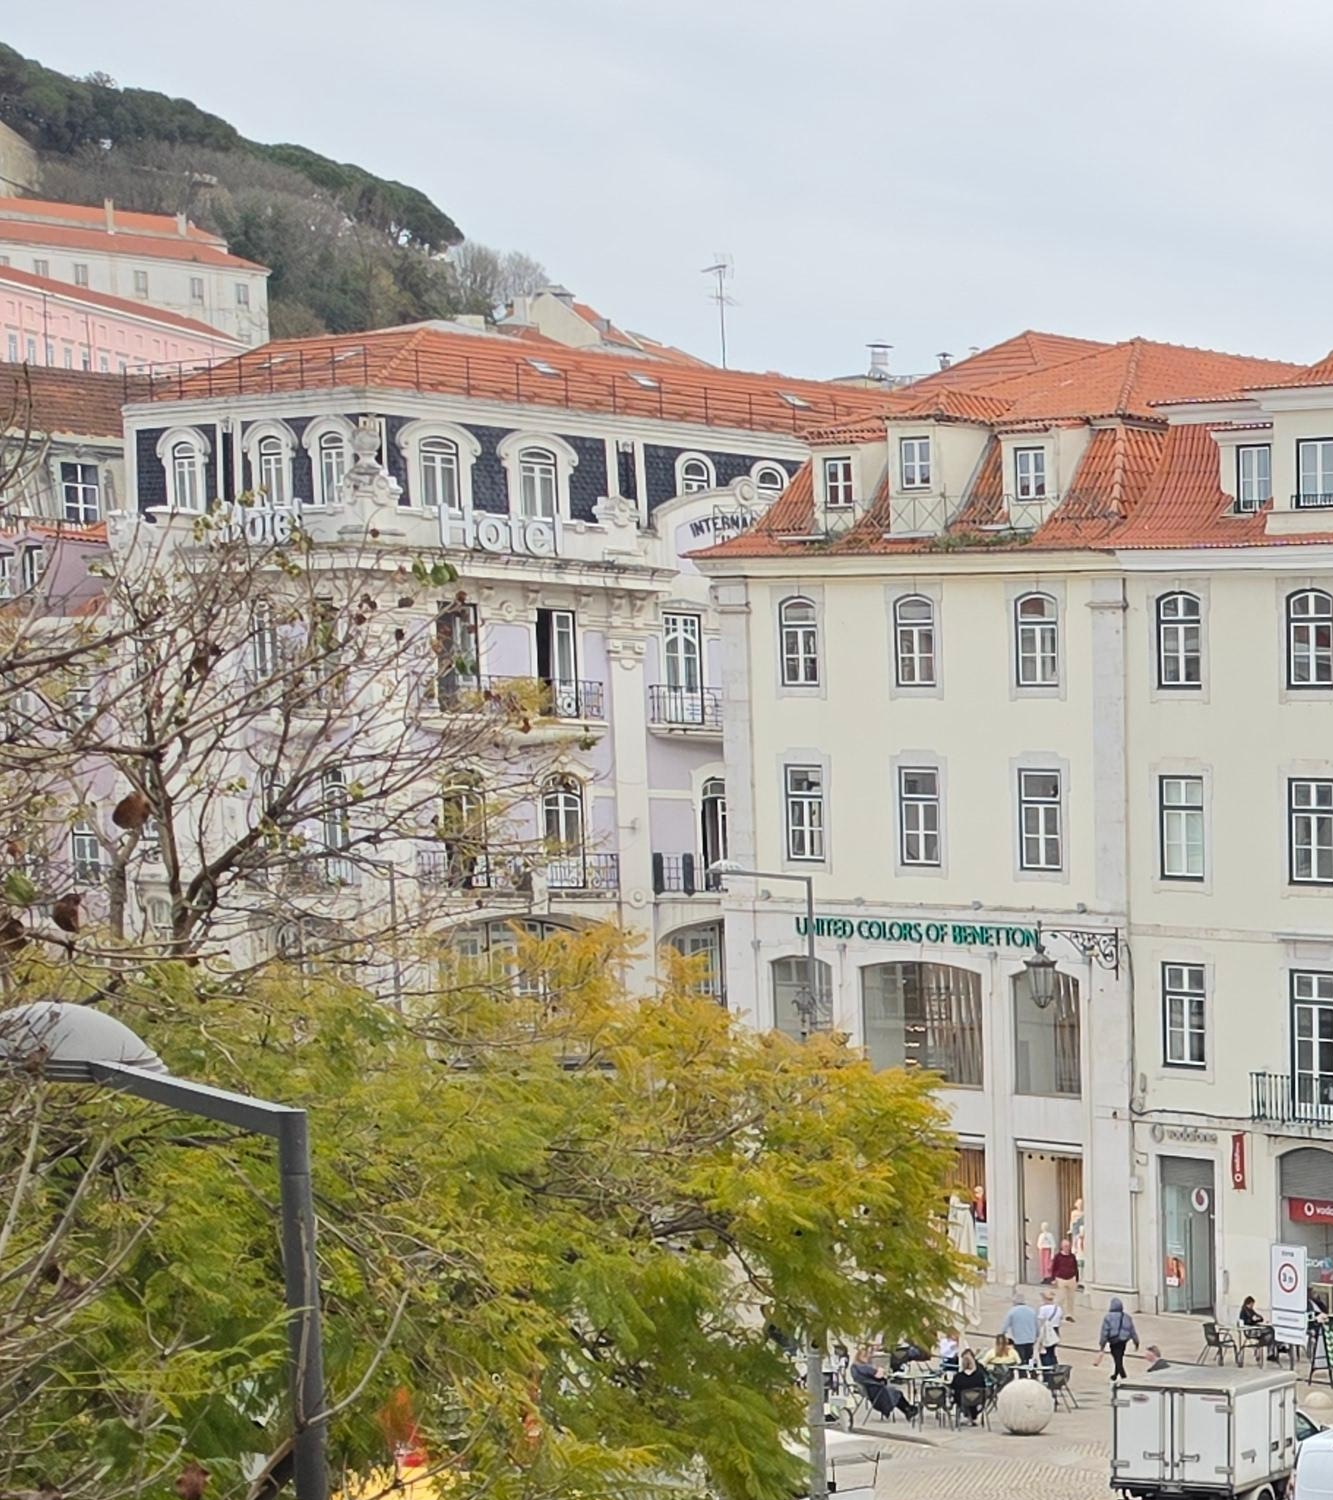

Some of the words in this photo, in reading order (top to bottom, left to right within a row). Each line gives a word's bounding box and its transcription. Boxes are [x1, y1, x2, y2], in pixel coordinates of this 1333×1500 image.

[439, 503, 563, 556] Hotel
[689, 515, 757, 538] INTERNA
[795, 917, 854, 938] UITED
[857, 920, 923, 943] COLORS
[925, 923, 948, 943] OF
[952, 925, 1039, 948] BENETTON
[1166, 1128, 1218, 1144] vodafone
